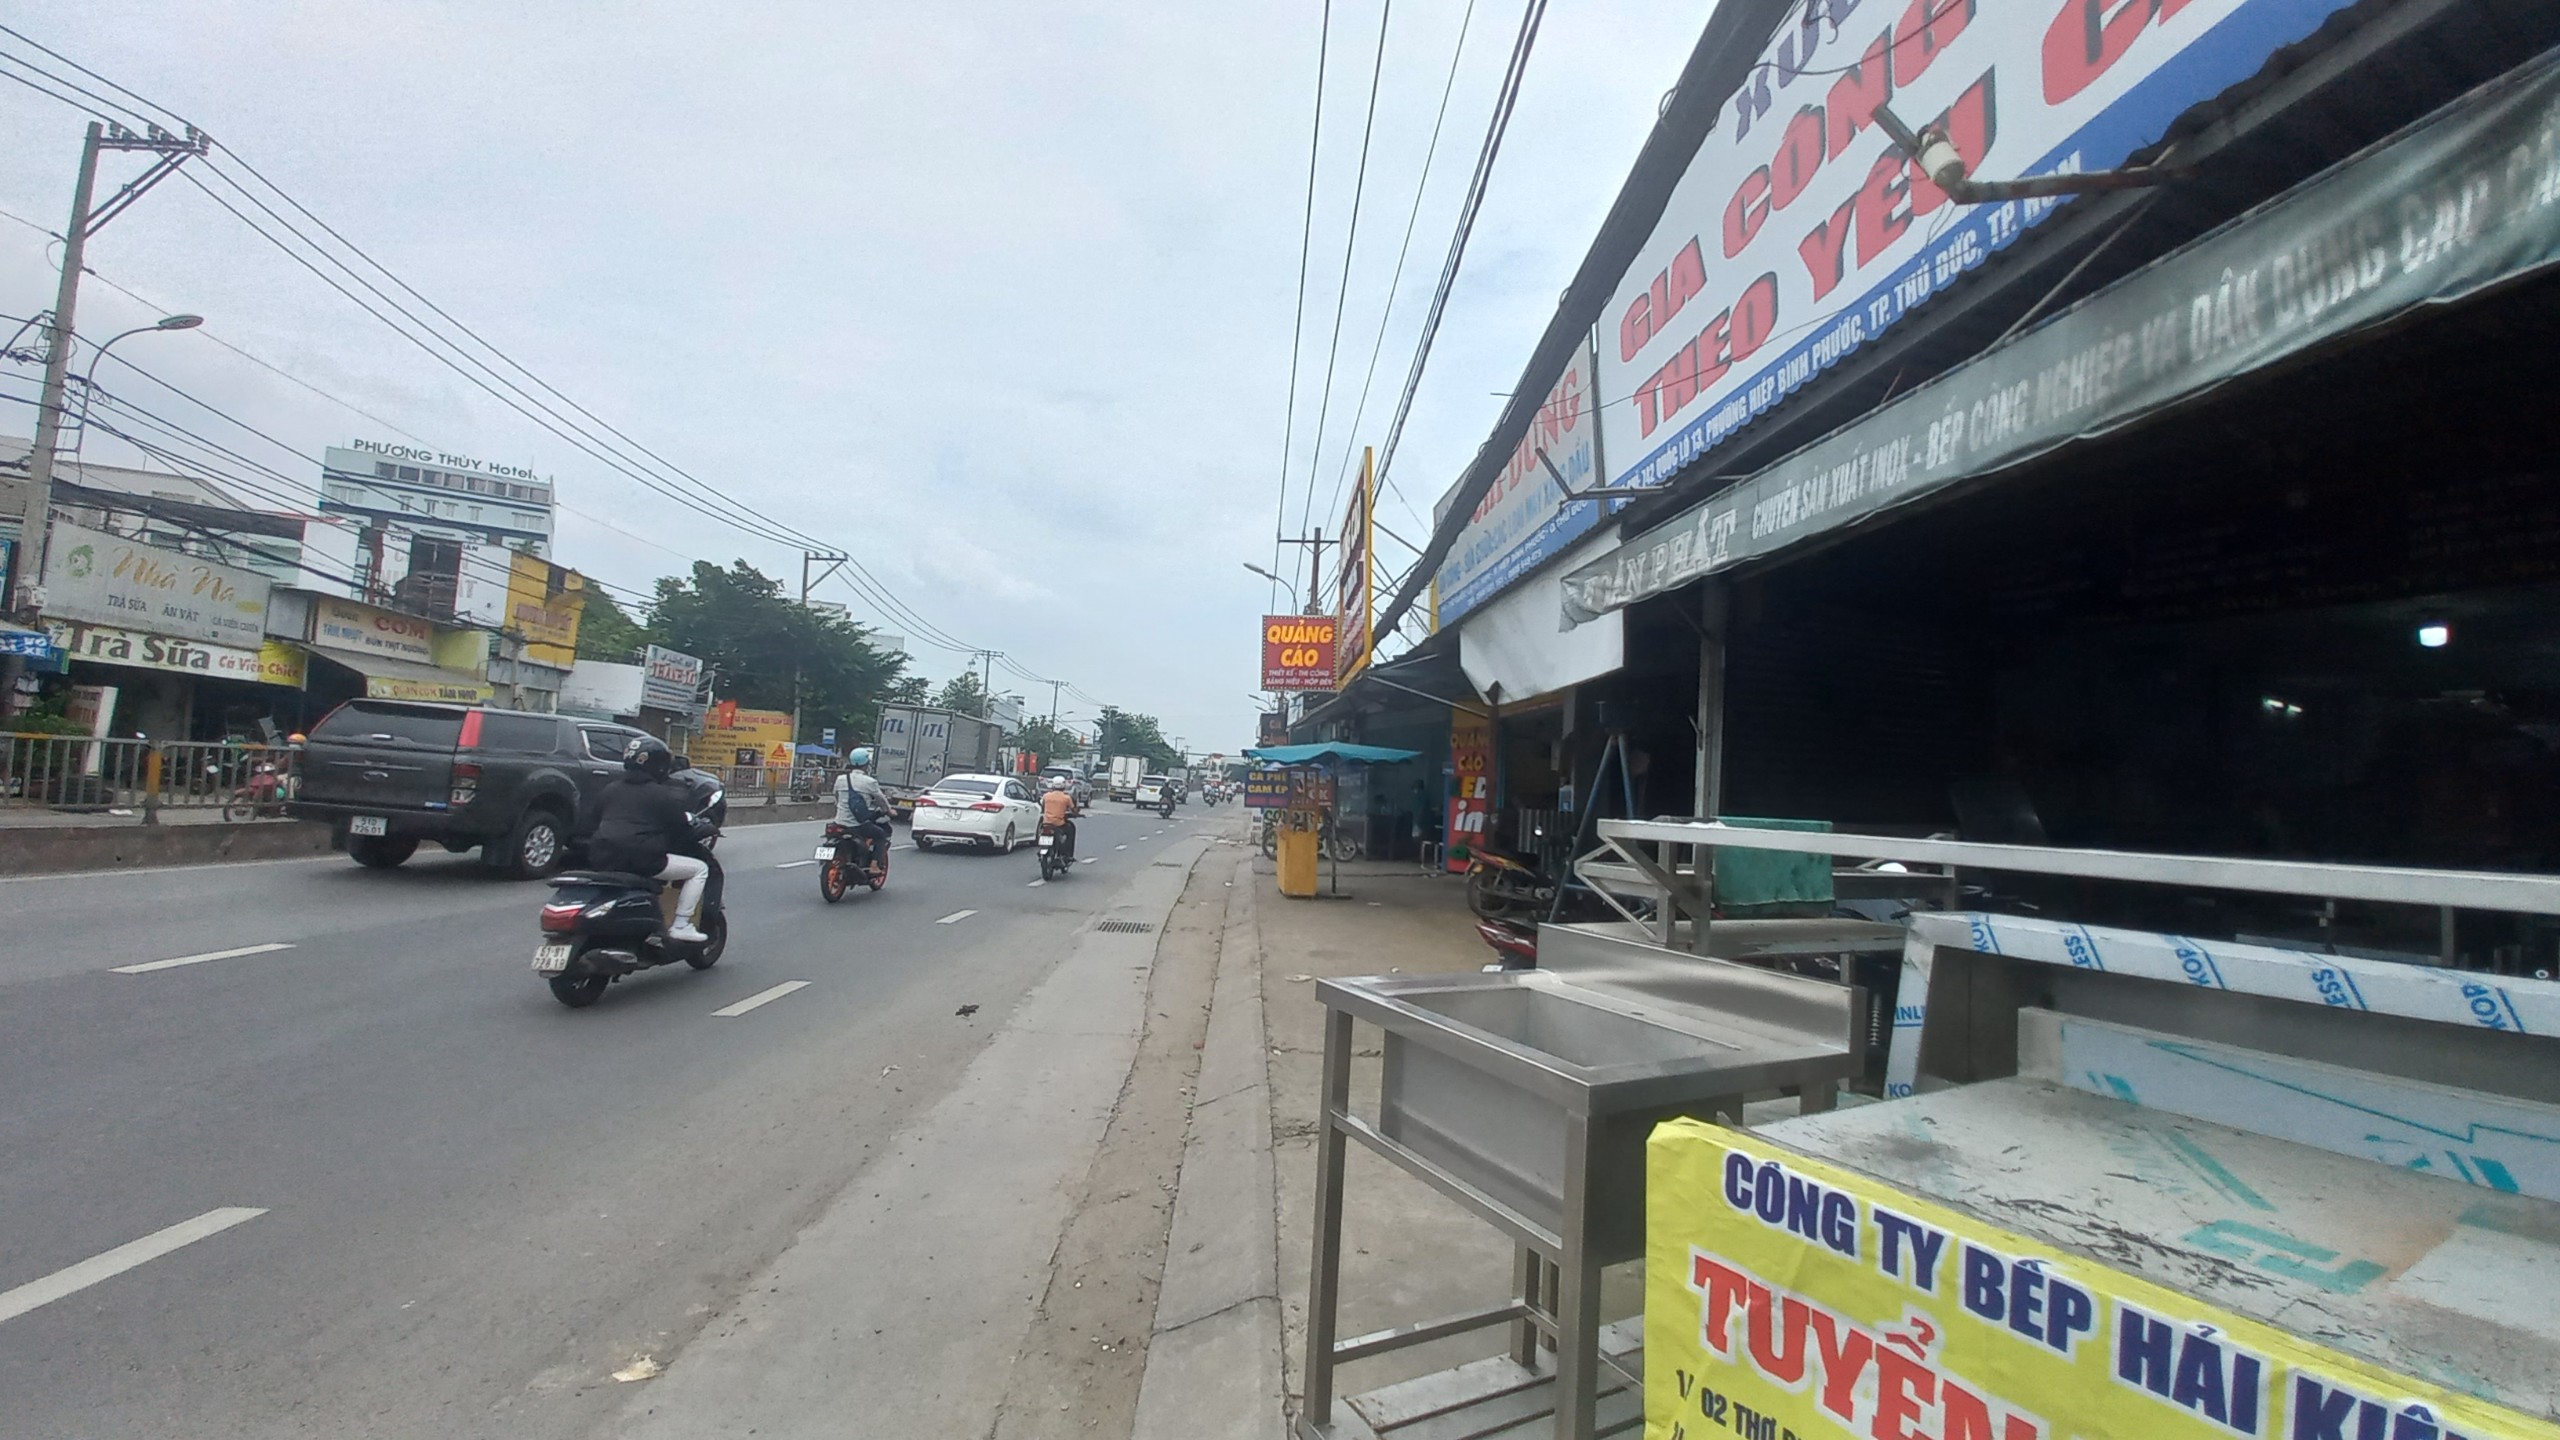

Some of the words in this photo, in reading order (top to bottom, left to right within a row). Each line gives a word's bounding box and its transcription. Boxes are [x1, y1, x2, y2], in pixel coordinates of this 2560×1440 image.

[1620, 234, 1708, 362] GIA
[1722, 0, 1976, 258] CÔNG
[1633, 271, 1778, 440] THEO
[1656, 444, 1678, 479] QUỐC
[1705, 396, 1747, 444] PHƯỜNG
[1748, 378, 1775, 421] HIỆP
[1776, 354, 1809, 396] BÌNH
[1811, 313, 1866, 370] PHƯỚC,
[1869, 298, 1891, 332] TP.
[1893, 257, 1931, 311] THỦ
[1935, 231, 1983, 290] ĐỨC,
[1986, 204, 2018, 248] TP.
[354, 438, 432, 462] PHƯƠNG
[439, 454, 482, 471] THÙY
[489, 462, 533, 479] Hotel
[1650, 508, 1738, 590] PHÁT
[1751, 479, 1800, 541] CHUYÊN
[1800, 464, 1829, 522] SẢN
[1829, 441, 1869, 509] XUẤT
[1869, 436, 1912, 491] INOX
[1926, 396, 1966, 465] BẾP
[1969, 380, 2029, 453] CÔNG
[112, 546, 179, 591] Nhà
[192, 565, 236, 602] Na
[142, 634, 211, 671] Sữa
[1267, 619, 1333, 645] QUẢNG
[1280, 644, 1319, 667] CÁO
[882, 718, 904, 733] ITL
[922, 723, 944, 738] ITL
[1454, 799, 1484, 833] in
[1724, 1151, 1857, 1258] CÔNG
[1874, 1208, 1946, 1292] TY
[1964, 1244, 2093, 1353] BẾP
[2118, 1306, 2261, 1436] HẢI
[1701, 1387, 1728, 1428] 02
